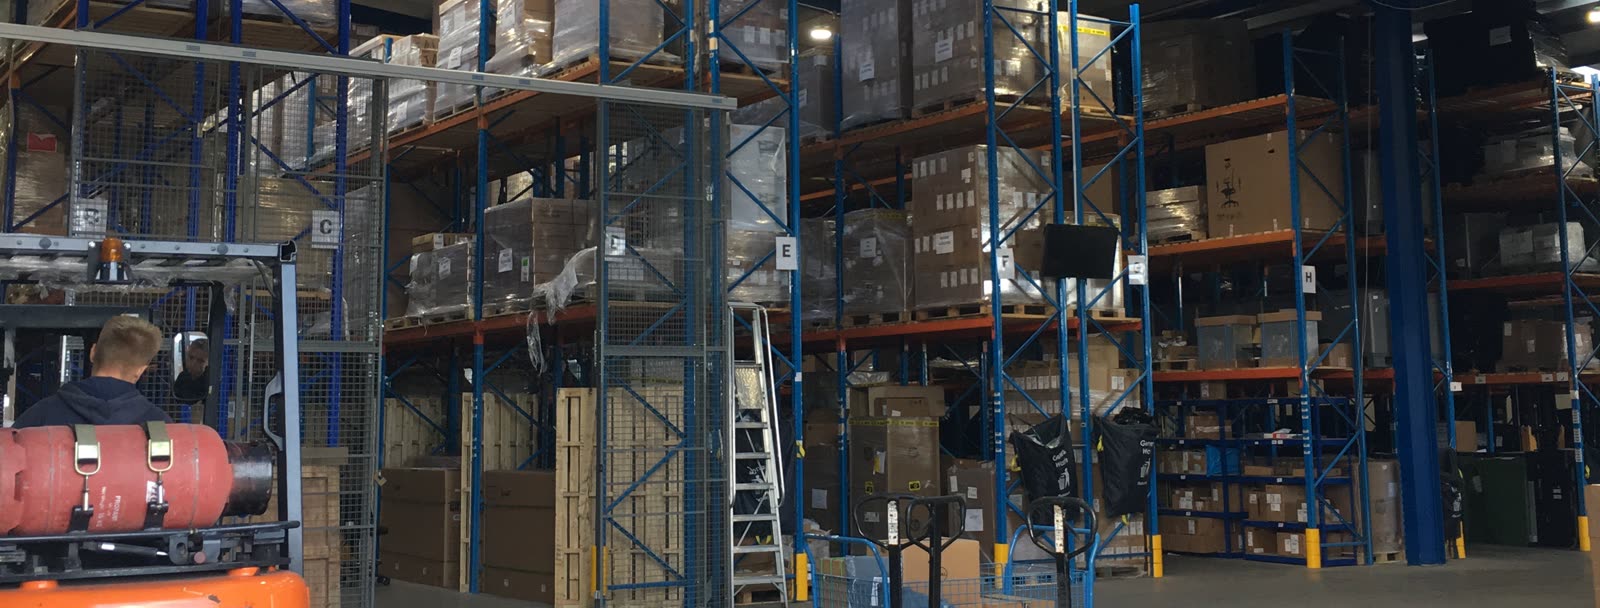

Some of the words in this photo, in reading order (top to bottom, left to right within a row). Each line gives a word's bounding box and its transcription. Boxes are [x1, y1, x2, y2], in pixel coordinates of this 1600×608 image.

[319, 219, 332, 235] C
[782, 244, 791, 257] E
[1001, 255, 1010, 269] F
[1305, 271, 1312, 283] H
